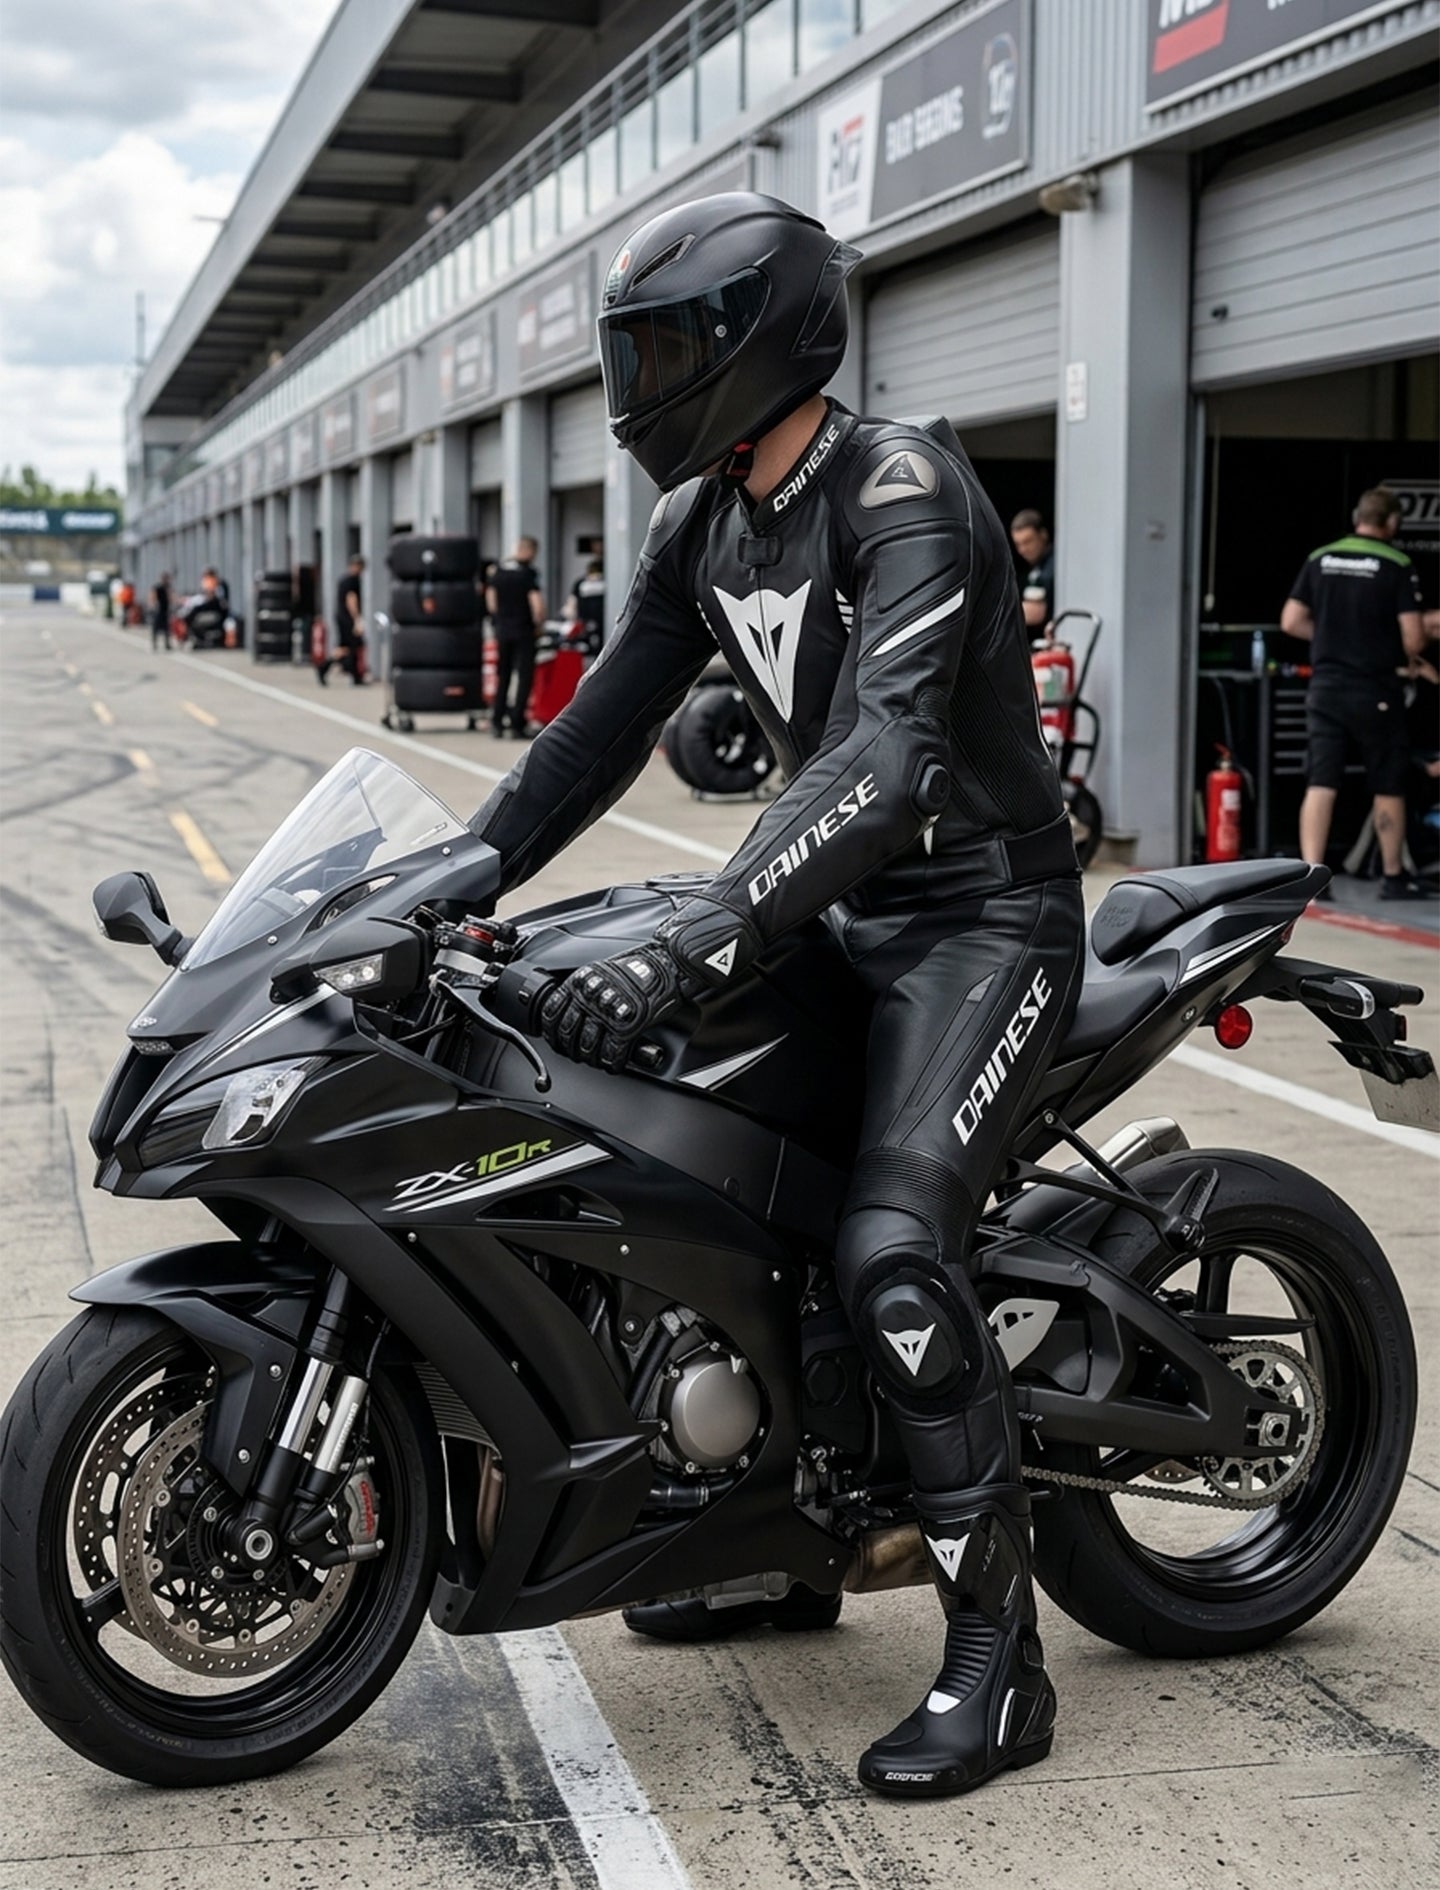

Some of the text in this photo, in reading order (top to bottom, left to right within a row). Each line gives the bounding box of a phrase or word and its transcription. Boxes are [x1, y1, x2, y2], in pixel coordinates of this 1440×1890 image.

[772, 424, 840, 513] DAINESE
[748, 773, 880, 907] DAINESE
[952, 966, 1052, 1146] DAINESE
[391, 1138, 552, 1201] ZX-10R
